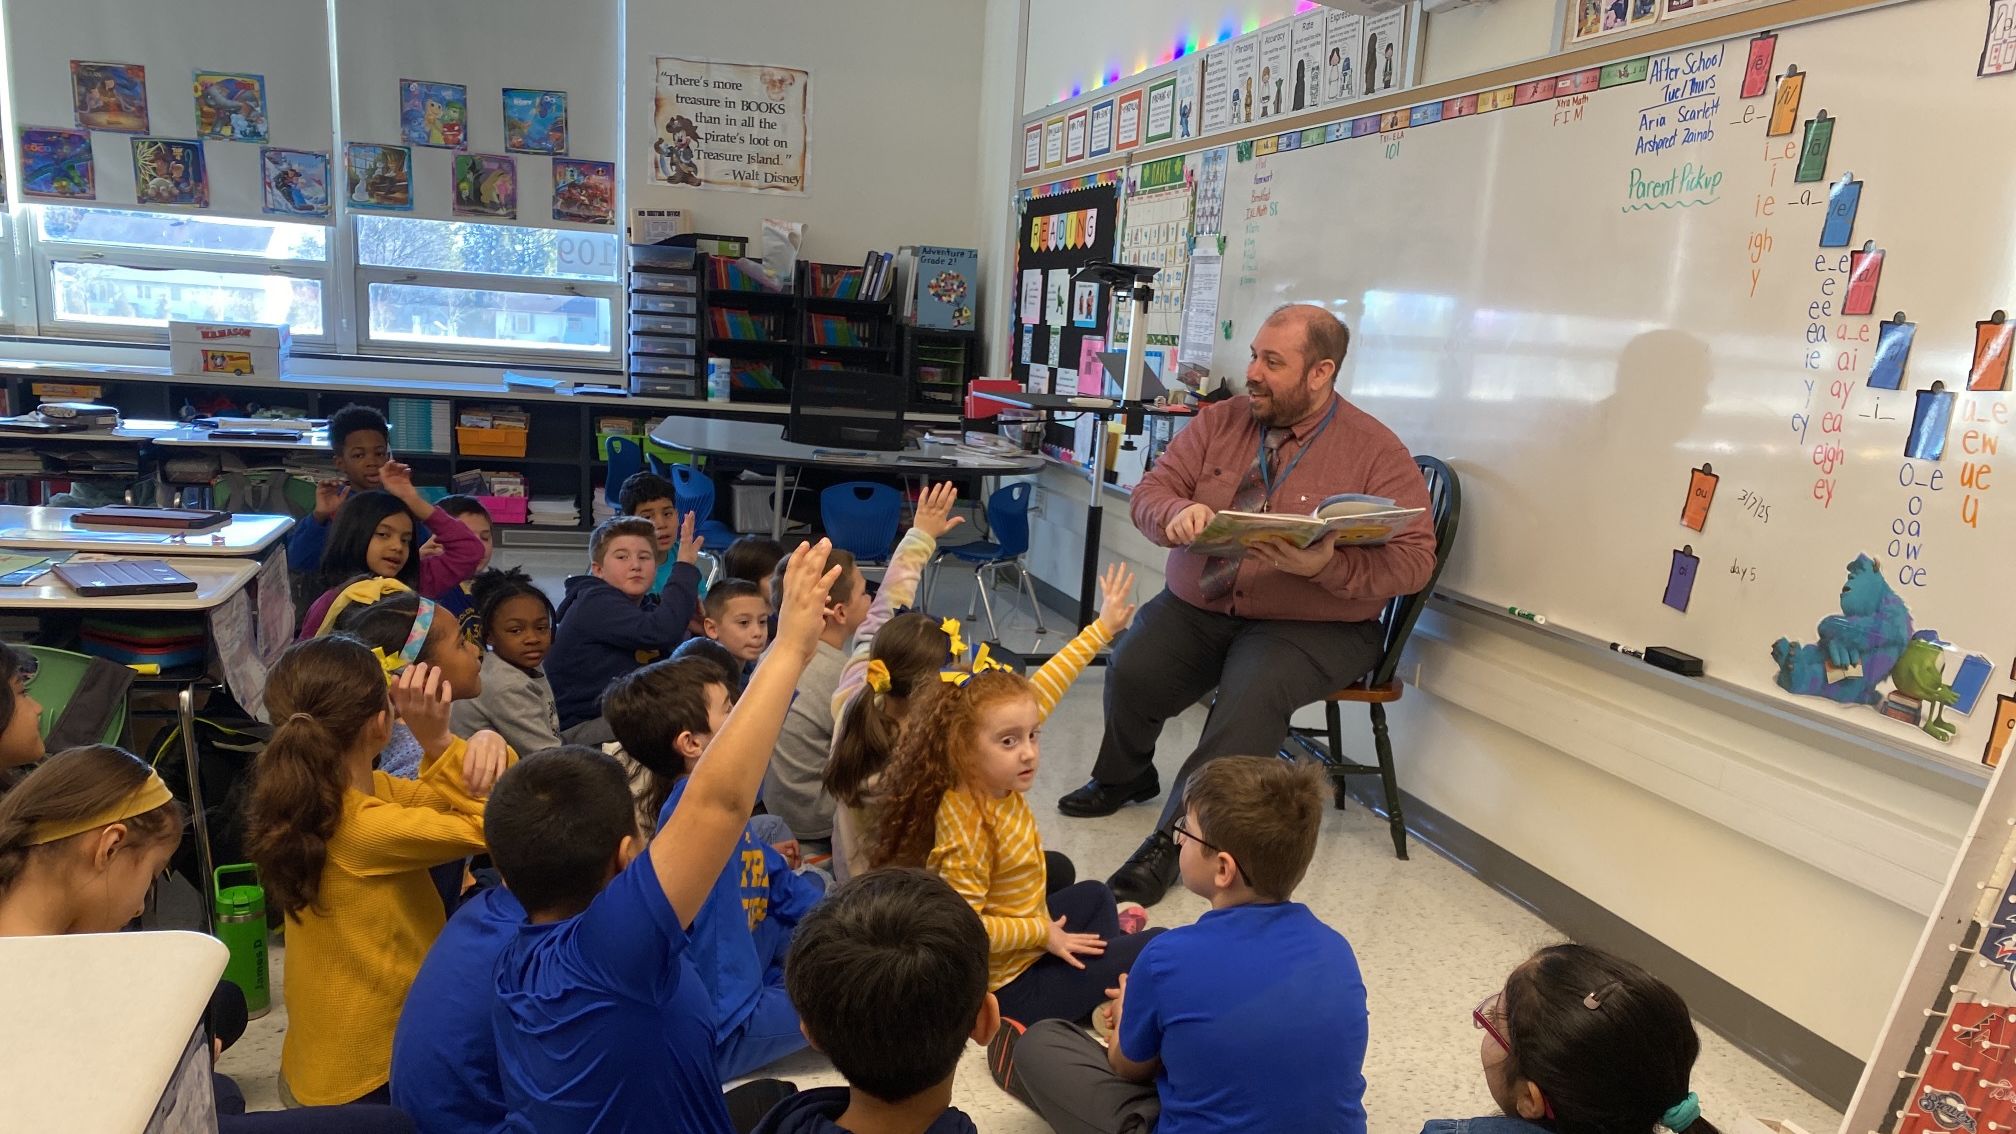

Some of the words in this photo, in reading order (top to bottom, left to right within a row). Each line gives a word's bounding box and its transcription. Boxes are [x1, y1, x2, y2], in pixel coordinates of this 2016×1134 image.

[1649, 57, 1680, 85] After
[1682, 44, 1725, 76] School
[713, 80, 742, 91] more
[675, 93, 721, 108] treasure
[725, 97, 736, 108] in
[741, 100, 786, 115] BOOKS
[1572, 94, 1589, 108] Math
[695, 112, 721, 125] than
[725, 115, 737, 127] in
[741, 116, 755, 128] all
[759, 118, 777, 130] the
[1639, 113, 1667, 132] Aria
[1677, 96, 1721, 123] Scarlett
[704, 131, 745, 144] pirate's
[750, 135, 770, 147] loot
[774, 138, 788, 149] on
[1681, 120, 1714, 146] Zainab
[694, 148, 743, 163] Treasure
[1385, 141, 1400, 160] 101
[764, 172, 802, 187] Disney
[1628, 168, 1680, 200] Parent
[1680, 161, 1723, 196] Pickup
[1755, 194, 1775, 218] ie
[1033, 214, 1094, 243] READING
[921, 247, 965, 257] Adventure
[1748, 228, 1773, 264] igh
[920, 255, 946, 265] Grade
[1749, 268, 1761, 298] y
[1821, 277, 1836, 296] e
[1808, 300, 1832, 320] ee
[1806, 322, 1827, 343] ea
[1804, 347, 1821, 369] ie
[1837, 348, 1858, 371] ai
[1830, 379, 1855, 410] ay
[1791, 412, 1810, 445] ey
[1822, 411, 1843, 433] ea
[1962, 429, 1998, 456] ew
[1813, 439, 1844, 475] eigh
[1960, 461, 1991, 490] ue
[1813, 478, 1836, 509] ey
[1737, 488, 1771, 524] 3/7/25
[1730, 558, 1747, 582] day
[1750, 567, 1757, 582] 5
[1899, 564, 1927, 587] oe
[253, 938, 263, 949] D
[254, 950, 265, 990] James
